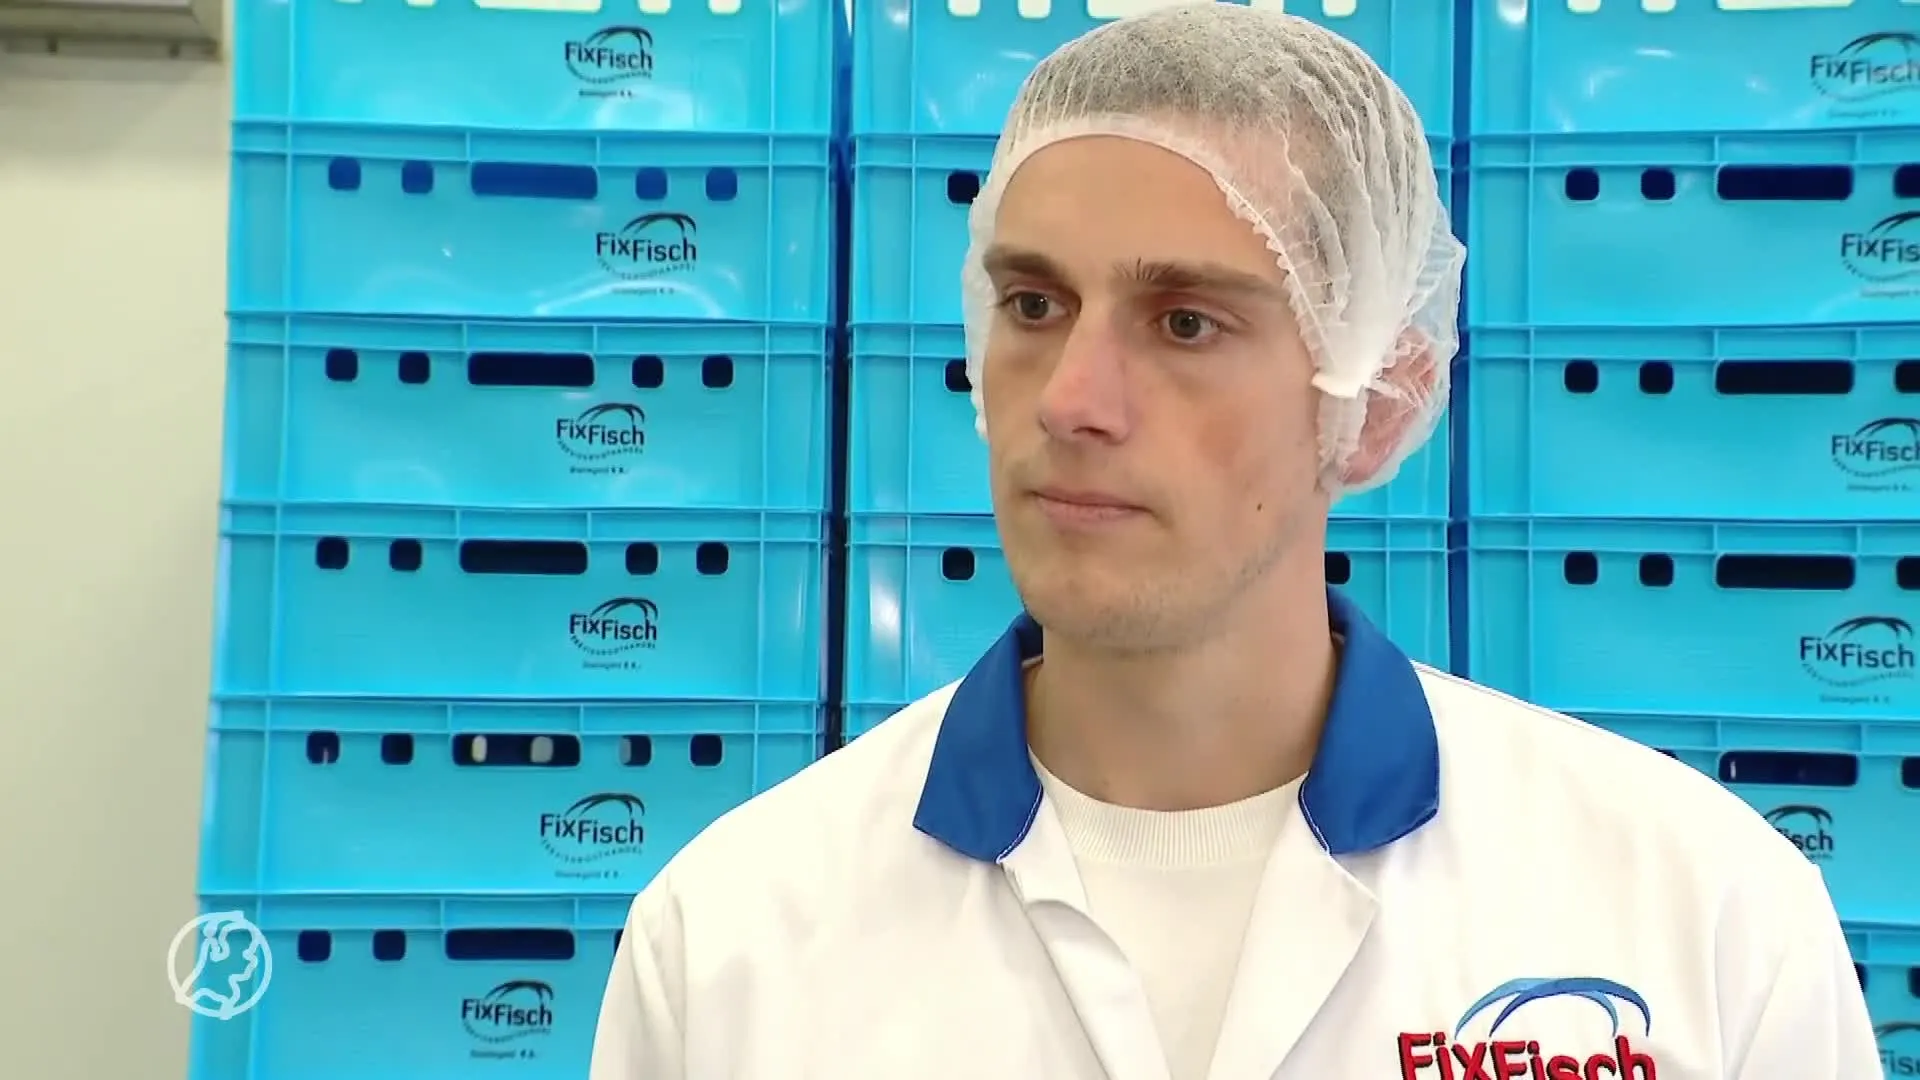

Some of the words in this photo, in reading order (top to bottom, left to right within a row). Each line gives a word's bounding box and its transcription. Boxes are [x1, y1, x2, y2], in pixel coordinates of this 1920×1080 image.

[564, 41, 653, 71] FixFisch
[596, 232, 697, 262] FixFisch
[557, 418, 645, 446] FixFisch
[569, 614, 657, 641] FixFisch
[1800, 636, 1915, 669] FixFisch
[540, 813, 645, 845] FixFisch
[462, 999, 553, 1026] FixFisch
[1397, 1031, 1657, 1080] FixFisch
